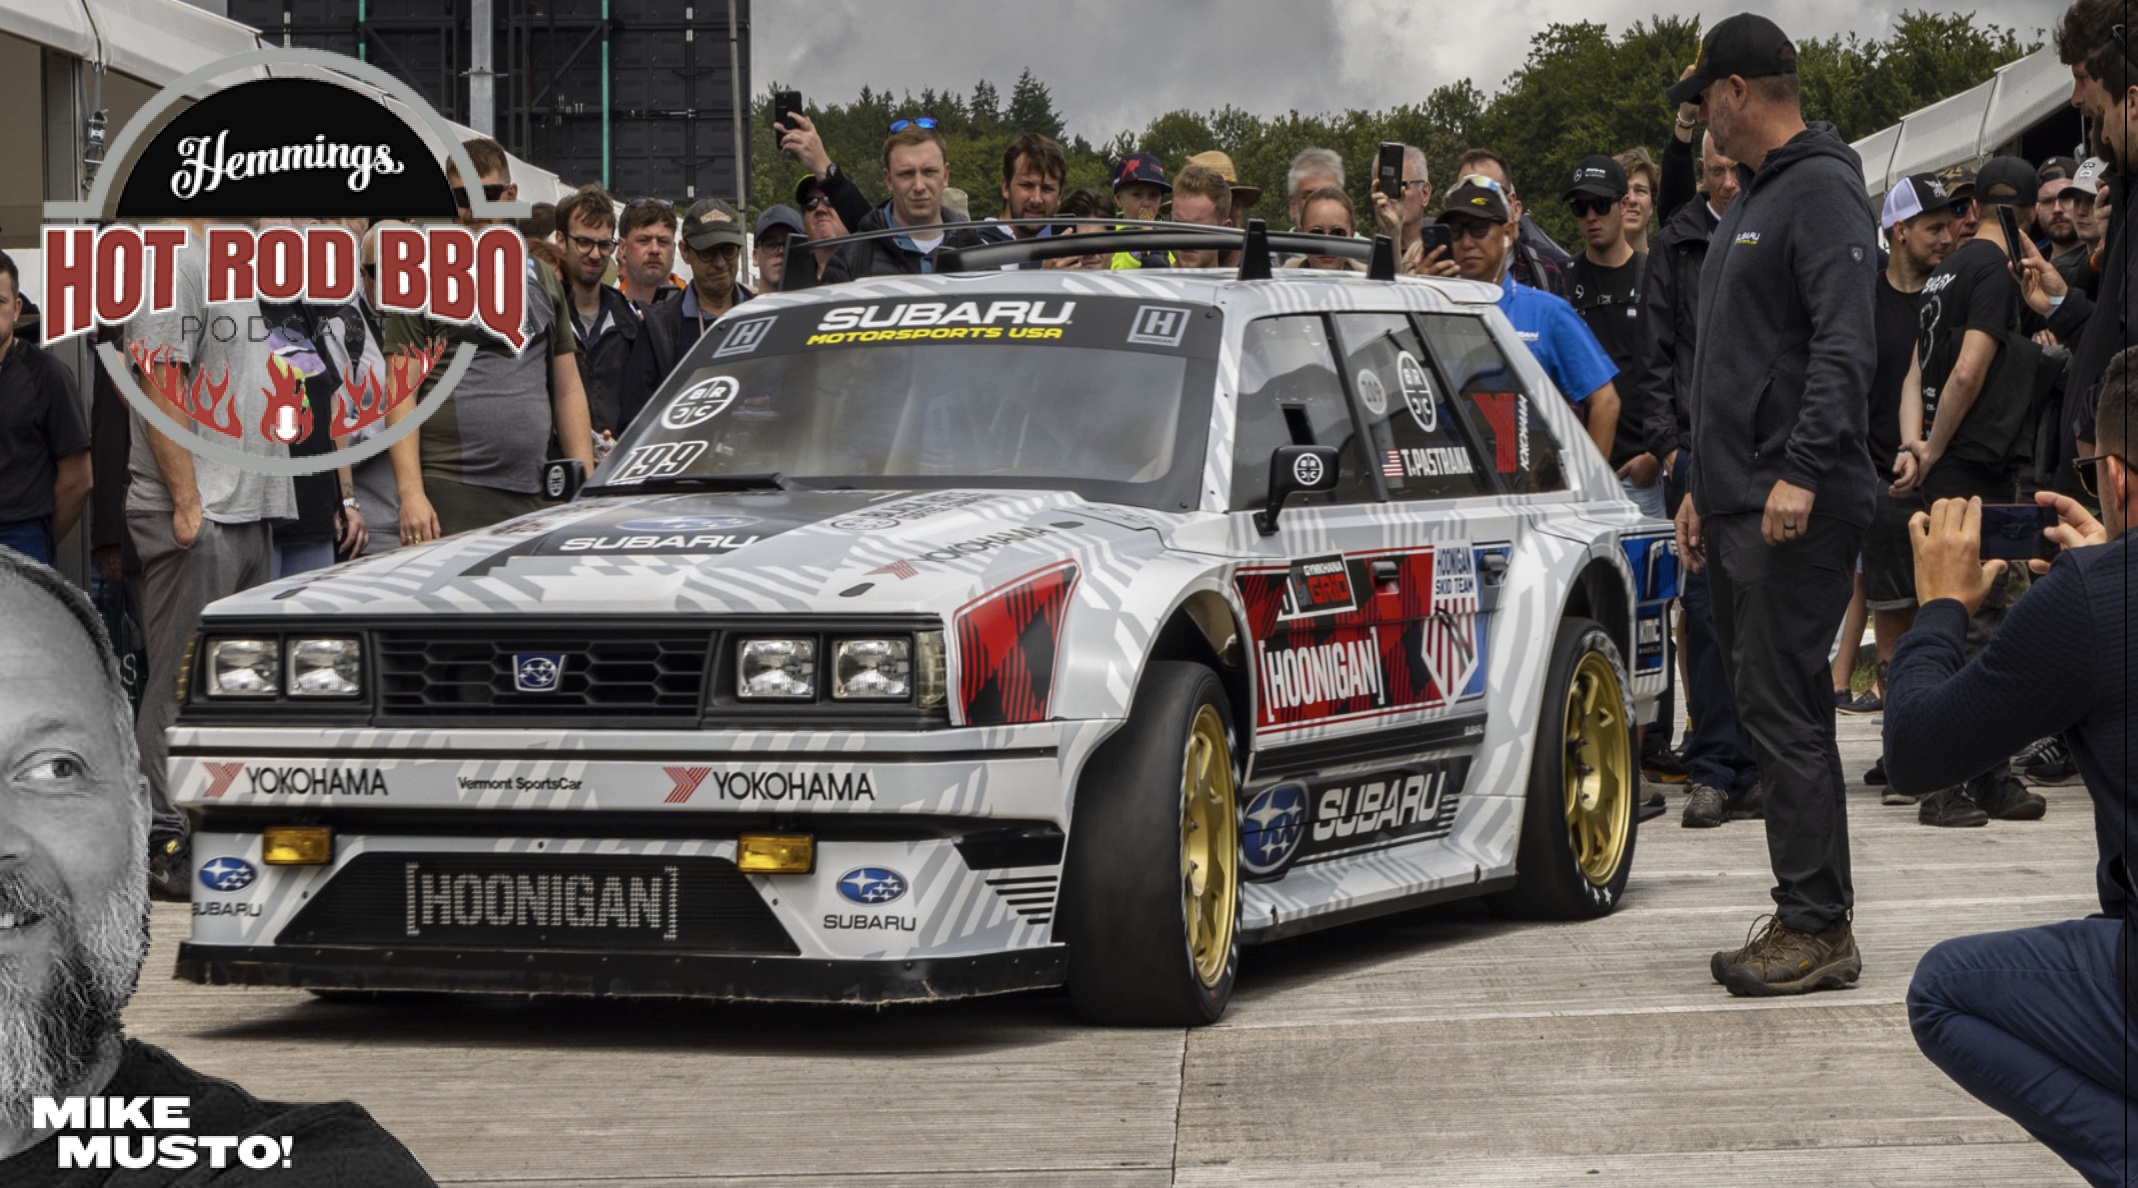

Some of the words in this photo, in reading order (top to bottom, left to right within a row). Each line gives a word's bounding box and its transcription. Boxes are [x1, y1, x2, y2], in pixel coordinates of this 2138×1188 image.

[817, 301, 1075, 331] SUBARU
[806, 327, 1003, 345] MOTORSPORTS
[1008, 327, 1063, 339] USA
[606, 440, 709, 486] 199
[559, 535, 761, 551] SUBARU
[908, 525, 1057, 563] YOKOHAMA
[1435, 578, 1452, 594] SKID
[1454, 577, 1475, 593] TEAM
[246, 766, 389, 795] YOKOHAMA
[458, 776, 512, 790] Vermont
[516, 776, 582, 792] SportsCar
[713, 771, 875, 801] YOKOHAMA
[1313, 771, 1447, 841] SUBARU
[823, 914, 917, 932] SUBARU
